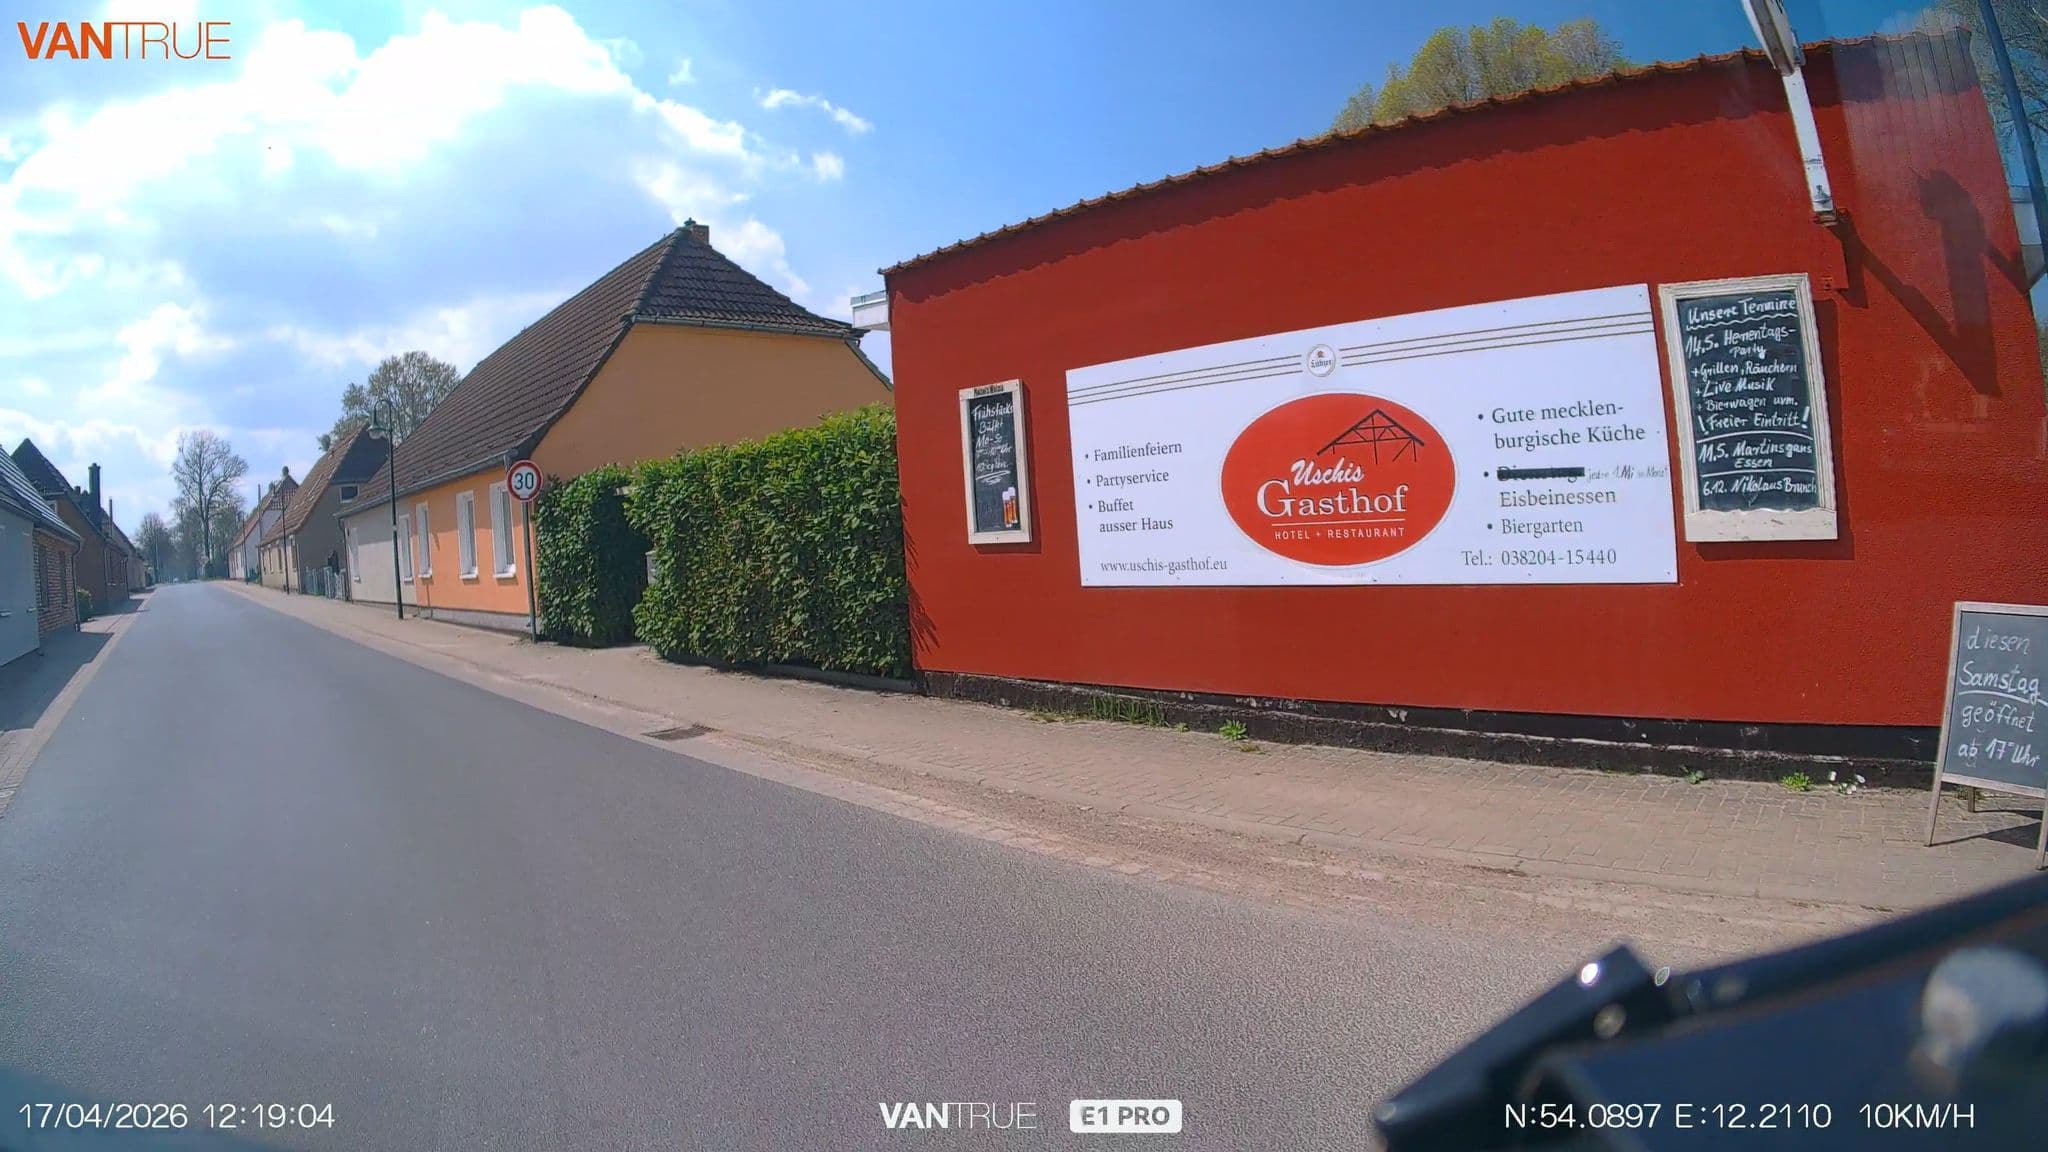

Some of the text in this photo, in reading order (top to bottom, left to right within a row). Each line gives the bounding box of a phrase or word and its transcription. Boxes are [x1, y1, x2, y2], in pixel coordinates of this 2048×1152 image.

[1688, 297, 1796, 324] Unsere Termine
[1491, 399, 1624, 424] Gute mecklen-
[1494, 424, 1646, 452] burgische Küche
[1094, 442, 1182, 462] Familienfeiern
[1291, 457, 1365, 487] Uschis
[1735, 458, 1773, 469] Essen
[514, 472, 534, 491] 30
[1096, 469, 1169, 489] Partyservice
[1098, 498, 1133, 513] Buffet
[1256, 479, 1408, 517] Gasthof
[1500, 488, 1616, 507] Eisbeinessen
[1099, 517, 1174, 533] ausser Haus
[1274, 530, 1310, 540] HOTEL
[1328, 527, 1405, 539] RESTAURANT
[1502, 518, 1584, 538] Biergarten
[1100, 557, 1227, 575] www.uschis-gasthof.eu
[1461, 548, 1617, 566] Tel.: 038204-15440
[1967, 625, 2031, 655] diesen
[1959, 660, 2041, 704] Samstag
[1962, 702, 2035, 732] geöffnet
